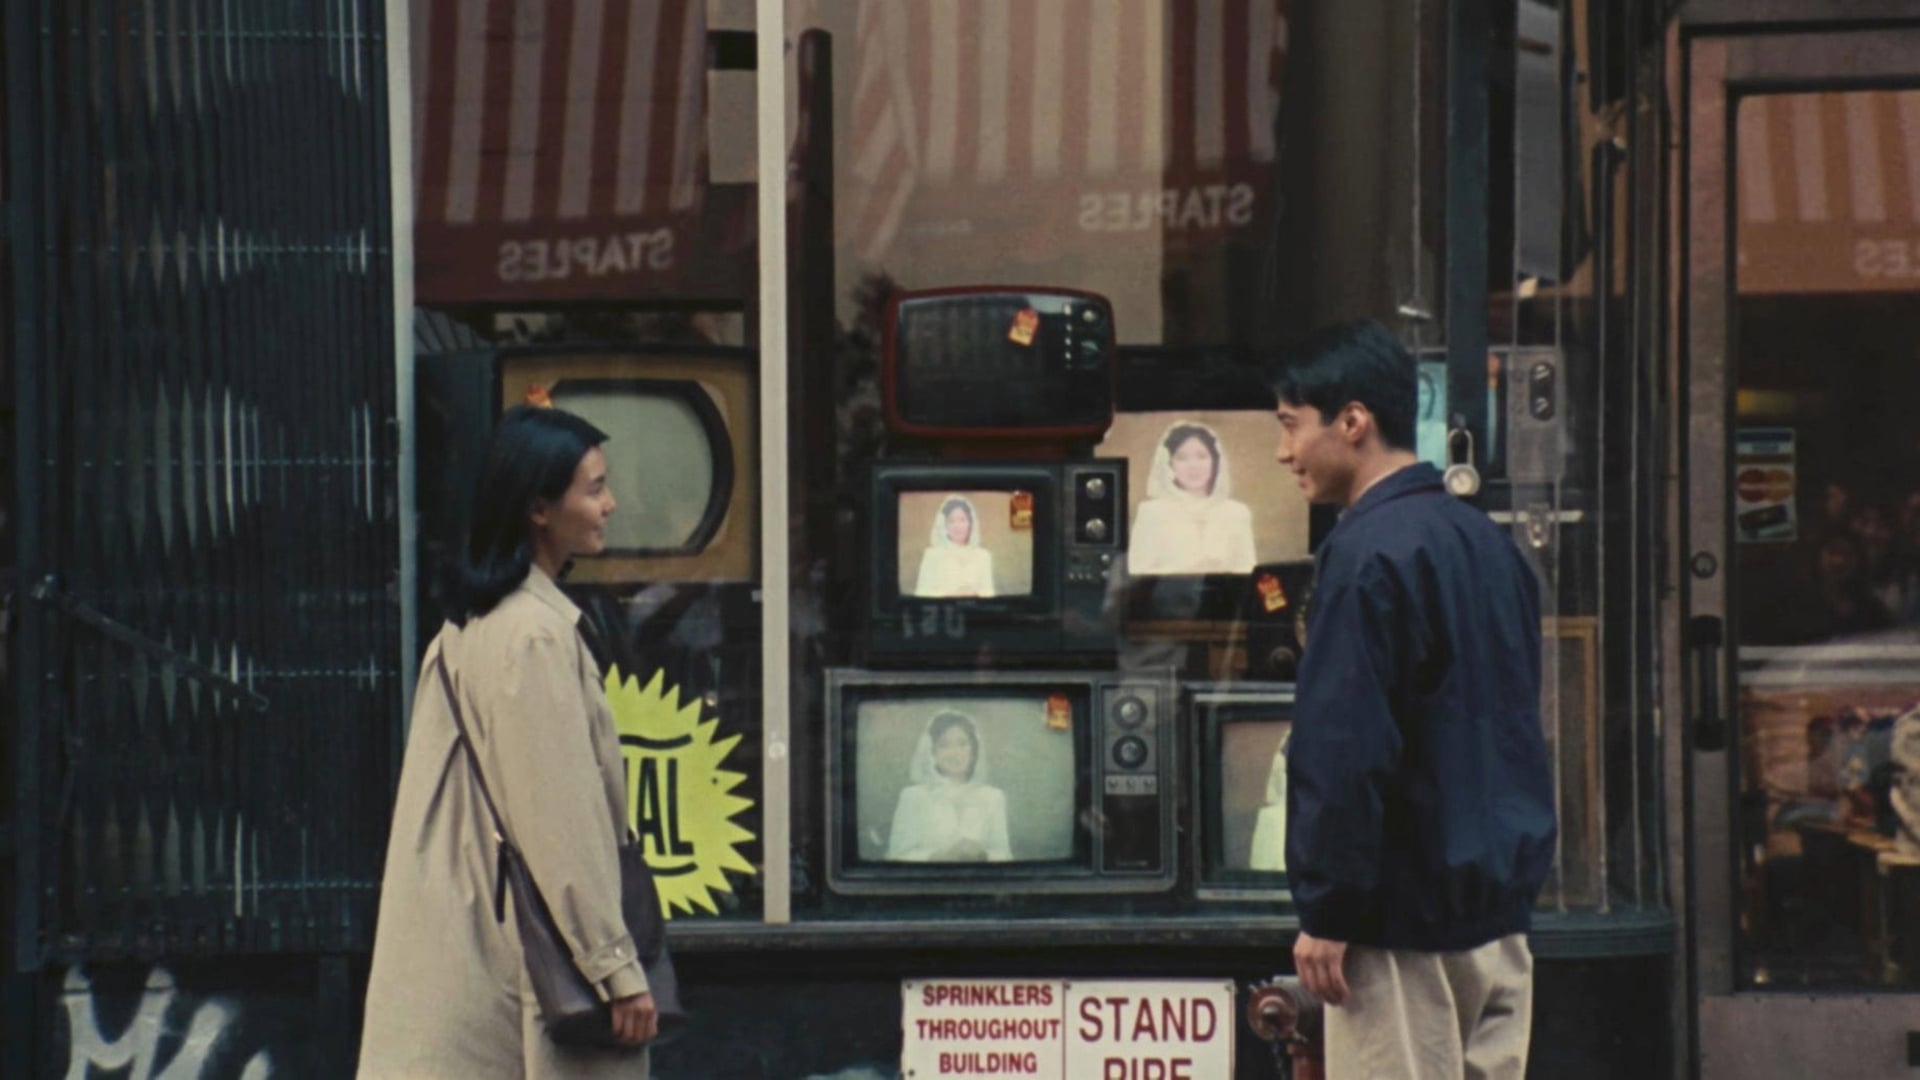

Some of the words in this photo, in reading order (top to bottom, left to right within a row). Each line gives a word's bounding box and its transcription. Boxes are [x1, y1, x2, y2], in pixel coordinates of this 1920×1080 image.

[624, 757, 694, 855] AL
[922, 984, 1053, 1005] SPRINKLERS
[916, 1019, 1060, 1039] THROUGHOUT
[1079, 996, 1216, 1042] STAND
[939, 1053, 1037, 1073] BUILDING
